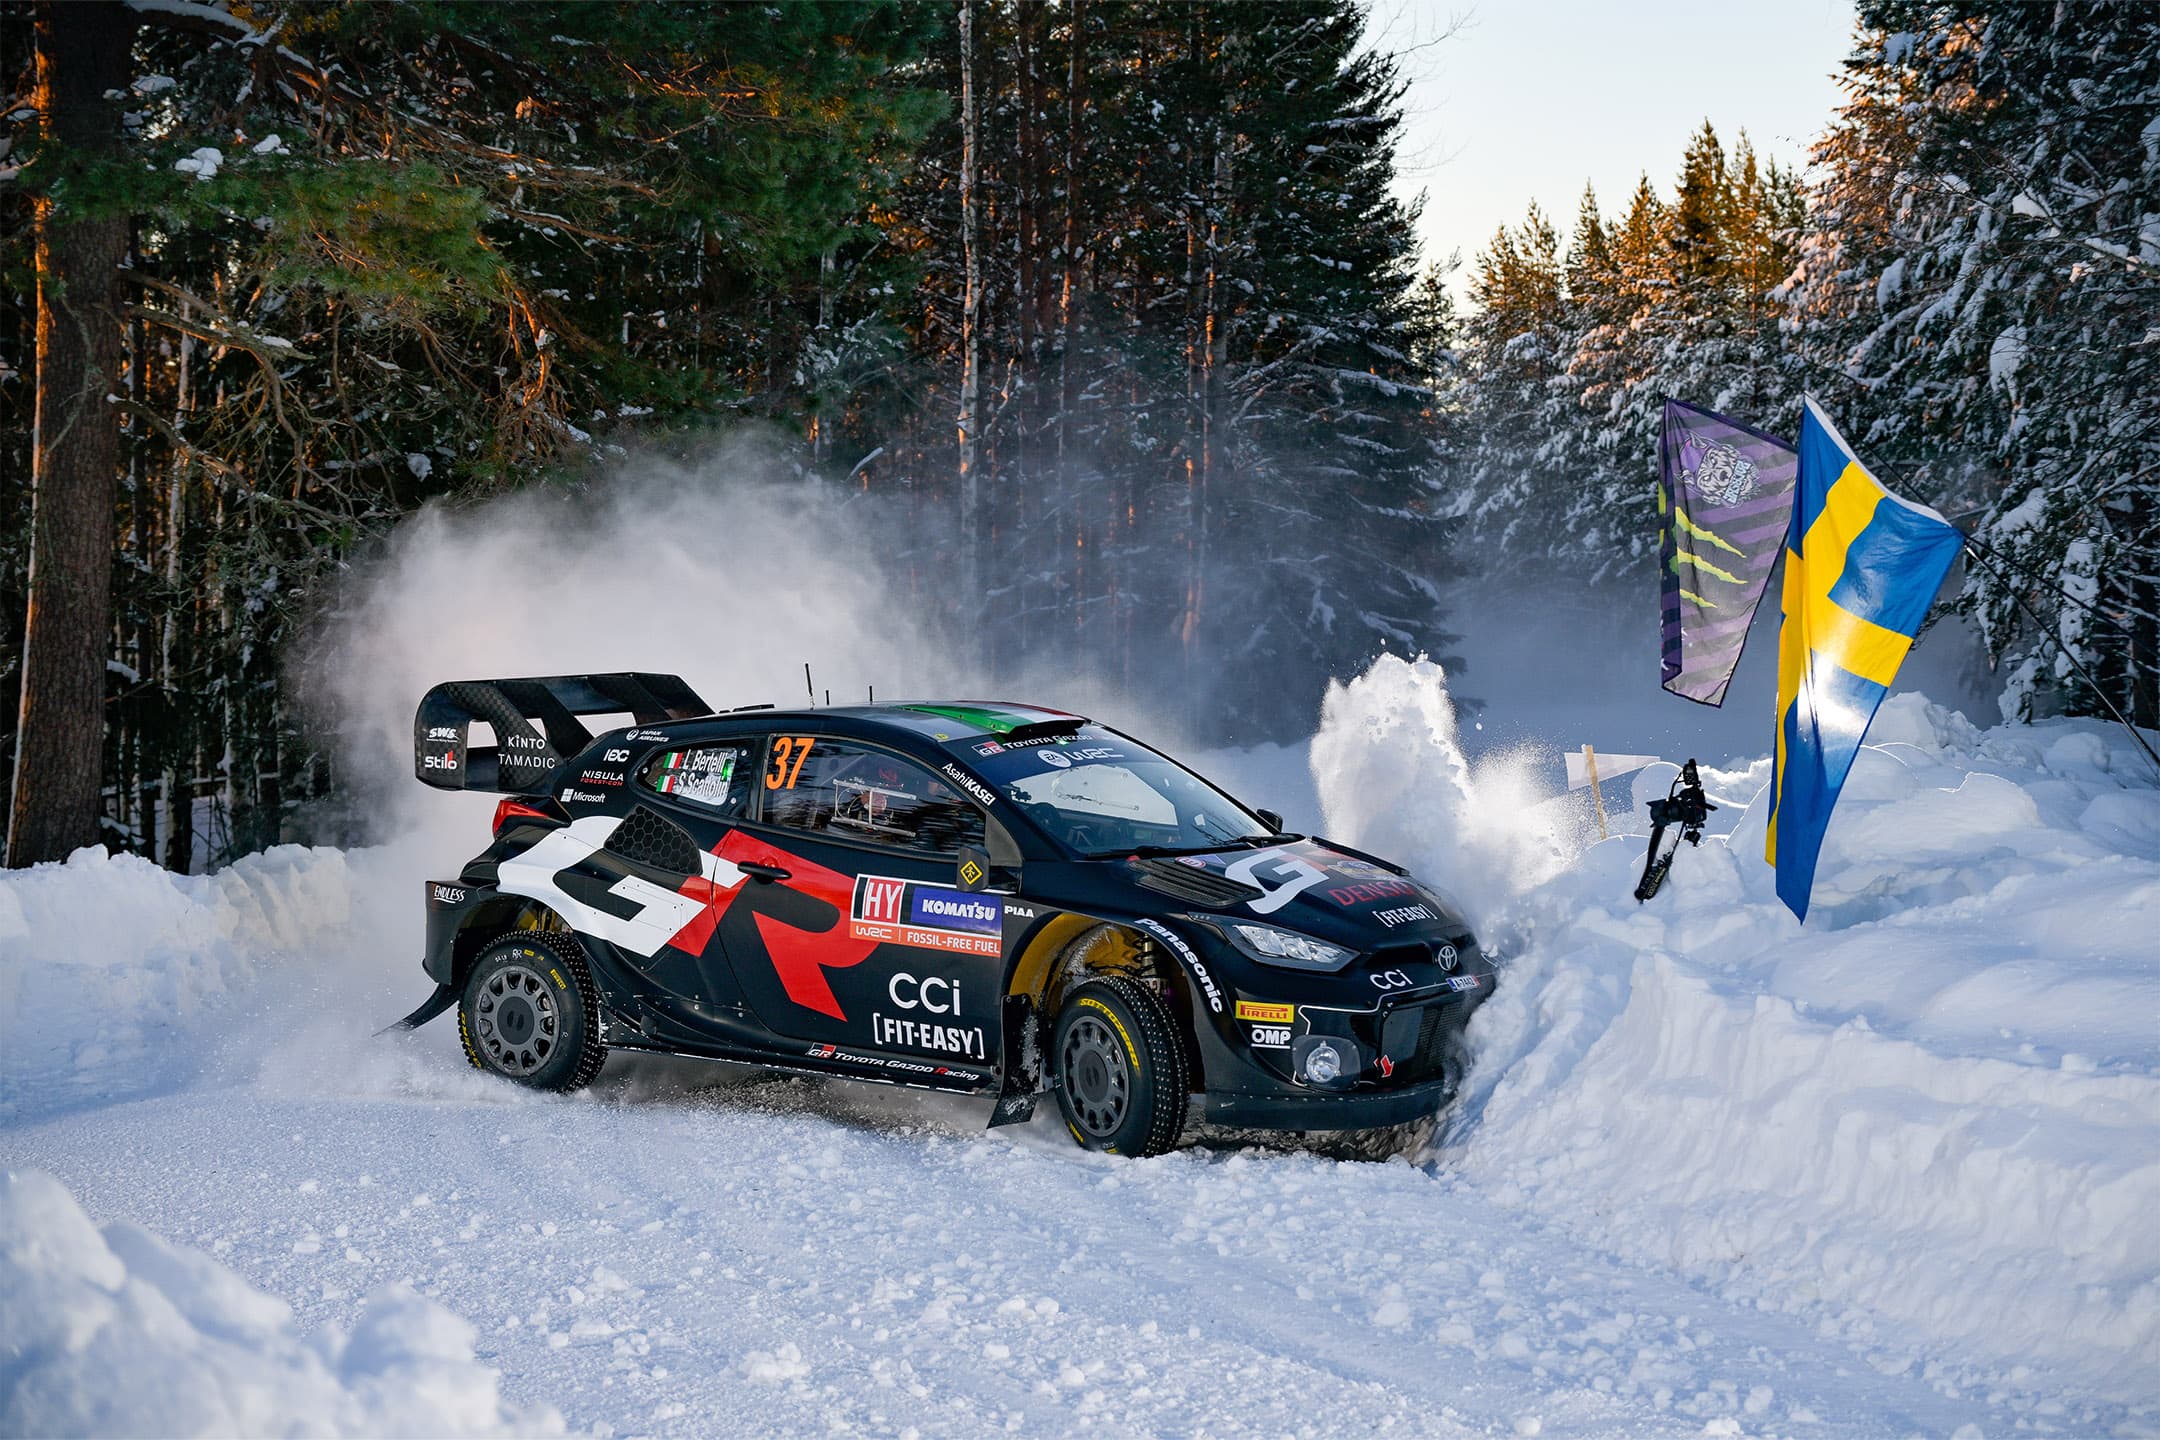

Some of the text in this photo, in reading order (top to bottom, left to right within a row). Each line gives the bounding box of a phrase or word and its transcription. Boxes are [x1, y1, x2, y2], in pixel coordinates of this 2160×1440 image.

[1002, 737, 1052, 749] TOYOTA
[424, 749, 457, 770] Stilo
[498, 753, 556, 769] TAMADIC
[766, 737, 815, 790] 37
[582, 769, 624, 782] NISULA
[942, 762, 996, 806] AsahiKASEI
[572, 790, 606, 803] Microsoft
[434, 885, 465, 902] ENDLESS
[864, 881, 902, 920] HY
[922, 898, 996, 921] KOMATSU
[1004, 904, 1034, 918] PIAA
[856, 925, 893, 940] WRC
[906, 931, 1000, 954] FOSSIL-FREE FUEL
[1134, 918, 1222, 1013] Panasonic
[1240, 1004, 1289, 1020] PIRELLI
[1251, 1028, 1292, 1045] OMP
[835, 1052, 884, 1066] TOYOTA
[886, 1060, 935, 1074] GAZOO
[934, 1066, 980, 1081] Racing
